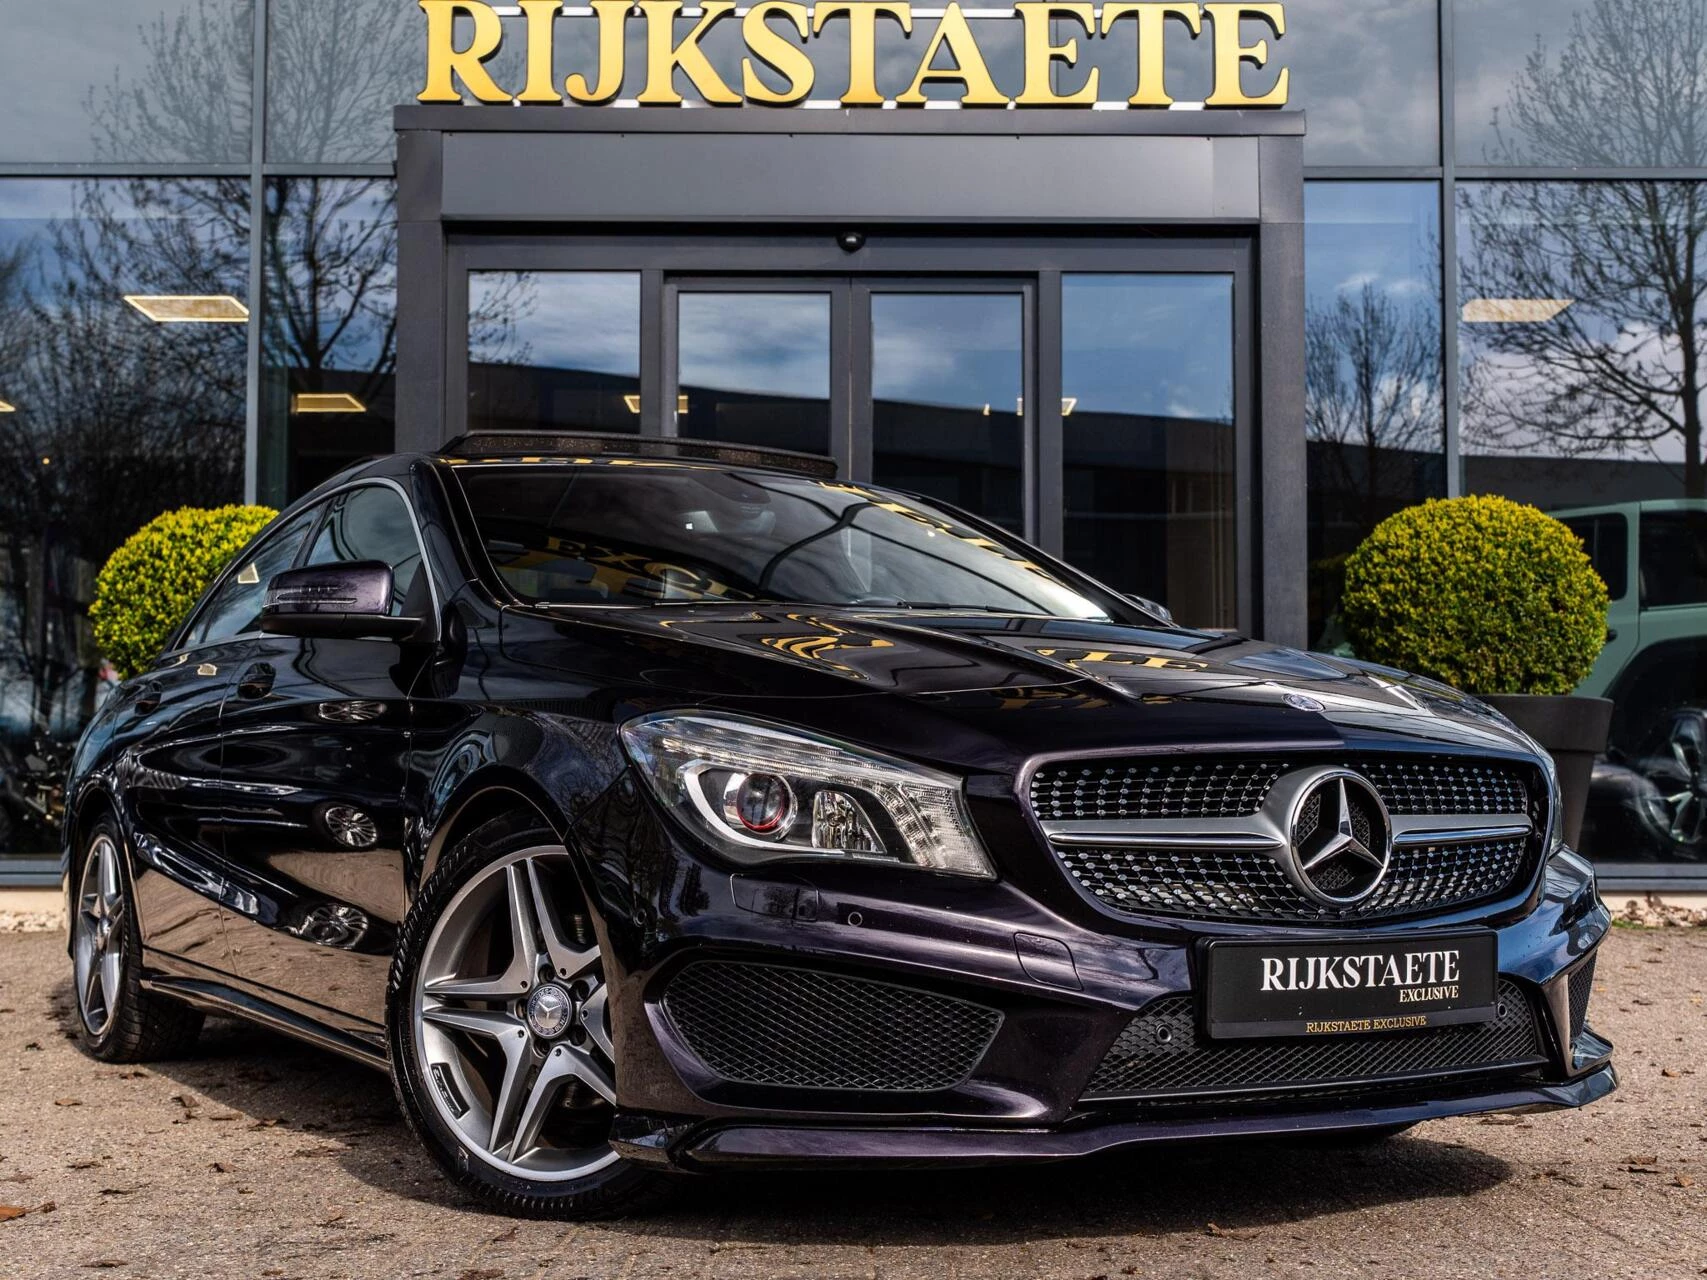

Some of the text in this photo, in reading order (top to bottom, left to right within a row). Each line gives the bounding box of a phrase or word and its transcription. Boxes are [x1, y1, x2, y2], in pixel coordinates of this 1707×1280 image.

[416, 0, 1289, 107] RIJKSTAETE
[1260, 950, 1460, 991] RIJKSTAETE
[1399, 985, 1459, 1003] EXCLUSIVE
[1306, 1015, 1427, 1034] RIJKSTAETE EXCLUSIVE
